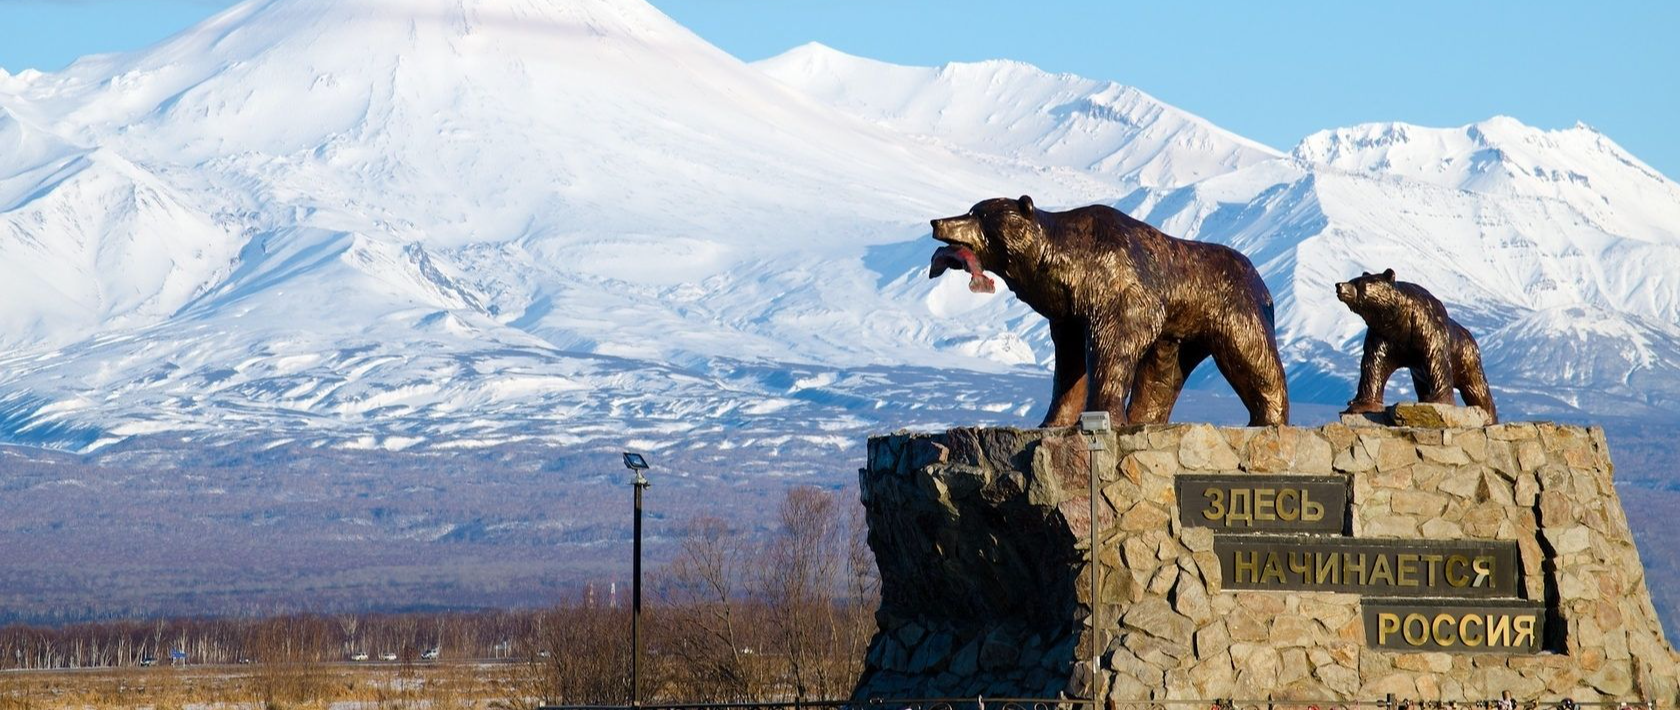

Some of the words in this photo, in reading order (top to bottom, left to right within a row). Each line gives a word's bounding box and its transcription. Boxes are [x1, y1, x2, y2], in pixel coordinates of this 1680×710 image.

[1202, 488, 1325, 527] ЗДЕСЬ
[1234, 551, 1496, 588] НАЧИНАЕТСЯ
[1378, 613, 1535, 647] РОССИЯ
